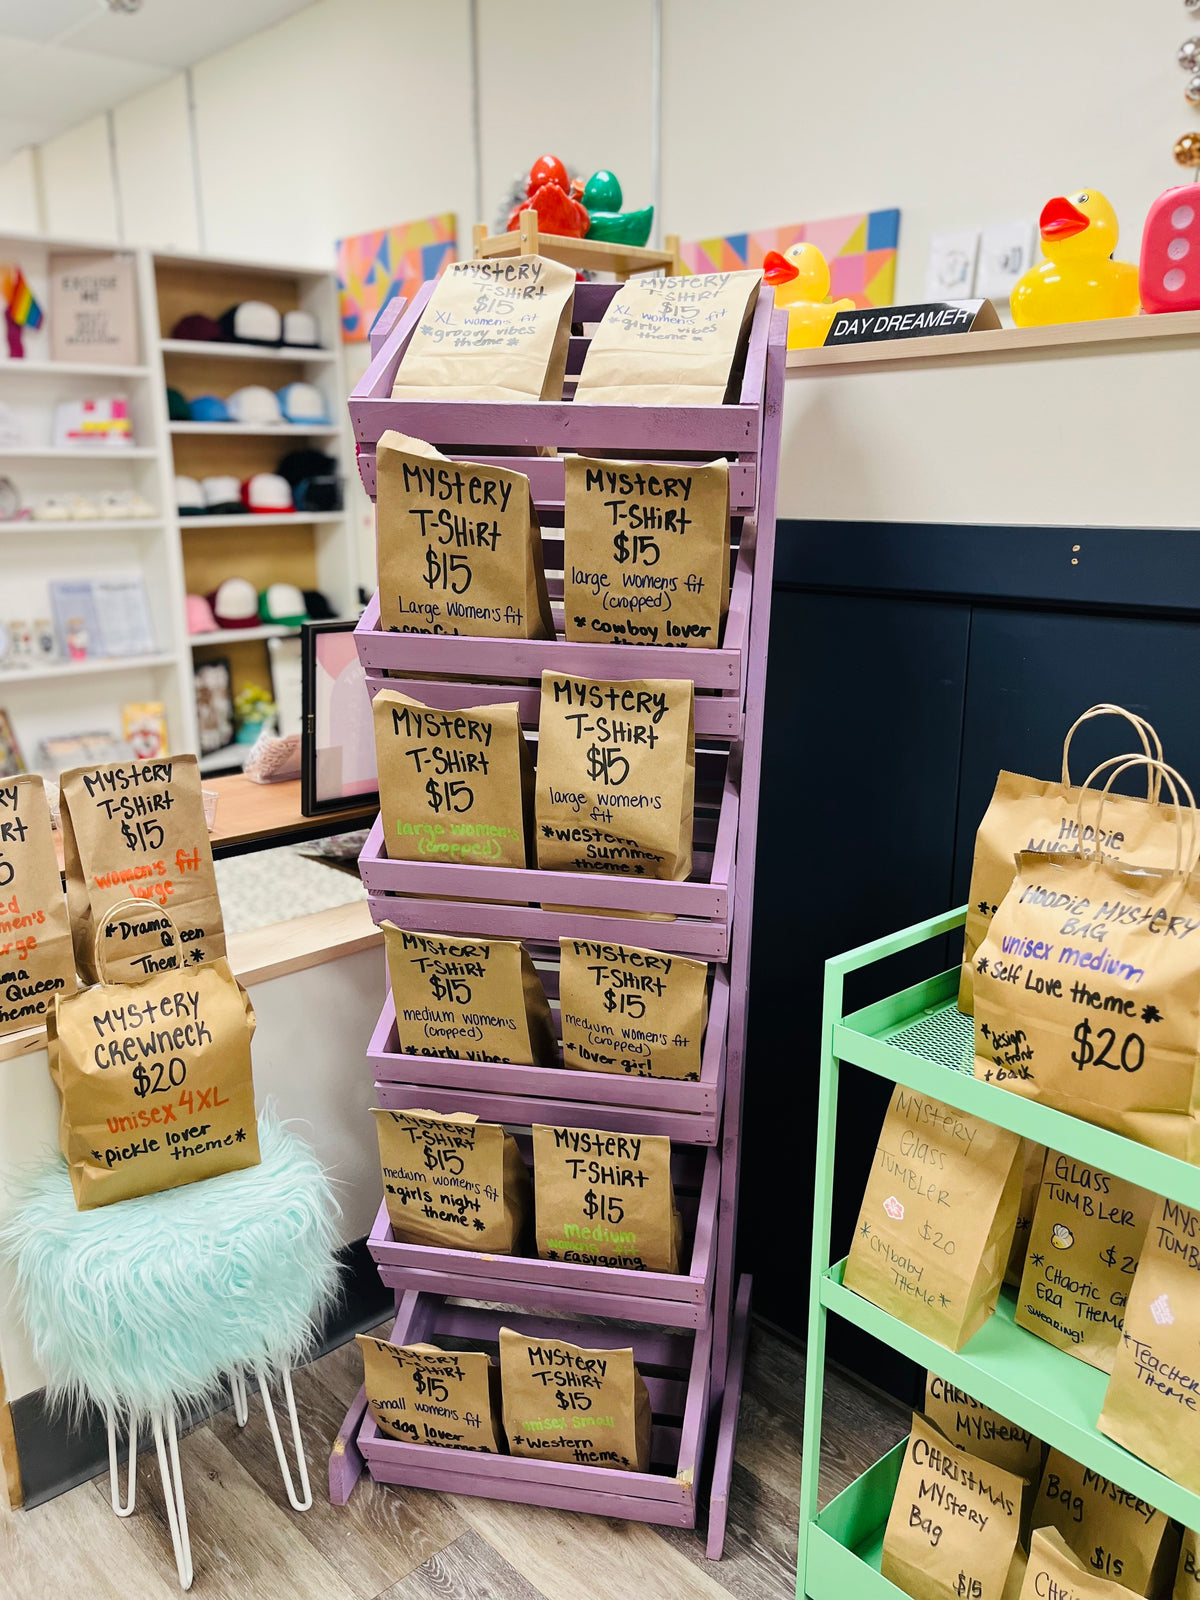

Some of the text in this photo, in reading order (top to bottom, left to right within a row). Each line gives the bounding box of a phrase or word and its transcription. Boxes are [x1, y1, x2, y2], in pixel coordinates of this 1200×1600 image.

[473, 294, 514, 315] $15
[658, 302, 700, 319] $15
[833, 309, 970, 336] DAY DREAMER
[613, 530, 660, 566] $15
[423, 544, 472, 594] $15
[684, 574, 705, 594] fit
[398, 596, 441, 624] Large
[503, 606, 524, 626] fit
[666, 620, 711, 637] lover
[586, 743, 630, 786] $15
[425, 777, 474, 813] $15
[589, 807, 613, 824] fit
[121, 819, 164, 851] $15
[175, 847, 202, 874] fit
[160, 927, 205, 948] Qeen
[1059, 918, 1109, 942] BAG
[5, 978, 65, 1002] Queen
[429, 974, 472, 1005] $15
[603, 988, 646, 1019] $15
[672, 1035, 690, 1047] fit
[1071, 1018, 1145, 1073] $20
[132, 1057, 186, 1098] $20
[621, 1059, 652, 1073] girl
[178, 1086, 230, 1115] 4XL
[166, 1124, 211, 1145] lover
[424, 1145, 464, 1175] $15
[440, 1194, 481, 1215] night
[483, 1185, 499, 1202] fit
[583, 1189, 624, 1224] $15
[918, 1220, 956, 1256] $20
[413, 1371, 449, 1402] $15
[555, 1390, 592, 1411] $15
[424, 1423, 465, 1441] lover
[463, 1412, 482, 1429] fit
[1046, 1474, 1084, 1523] Bag
[909, 1504, 943, 1548] Bag
[1090, 1546, 1124, 1576] $15
[953, 1570, 983, 1600] $15
